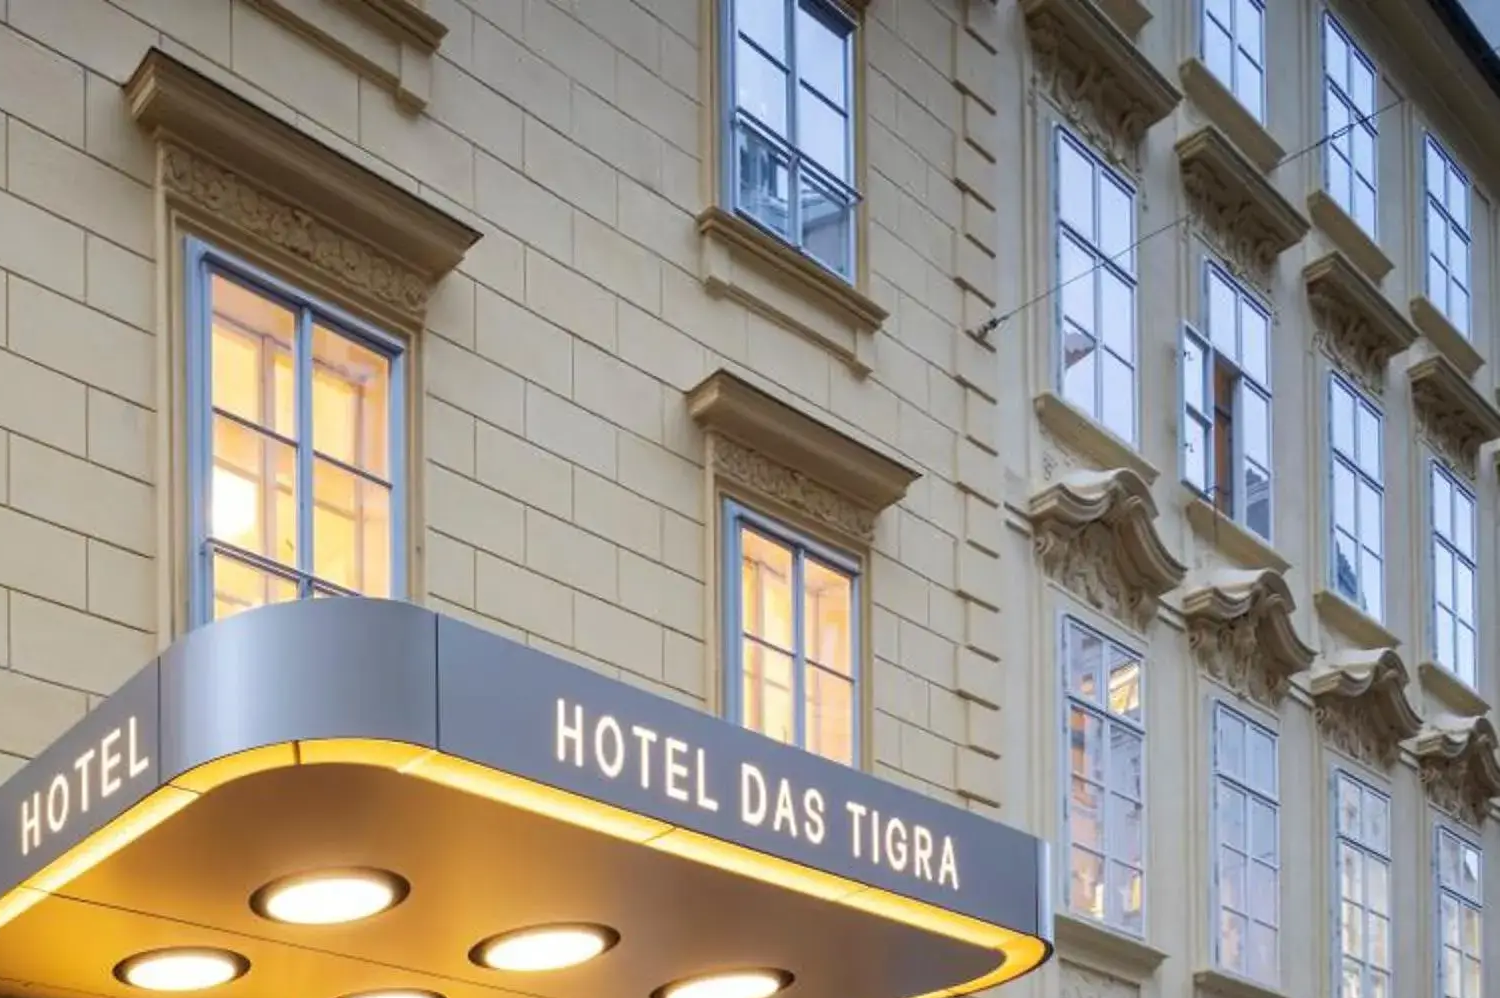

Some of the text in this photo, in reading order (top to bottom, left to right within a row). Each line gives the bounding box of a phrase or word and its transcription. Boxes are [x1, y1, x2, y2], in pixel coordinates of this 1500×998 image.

[21, 715, 149, 856] HOTEL
[556, 698, 960, 890] HOTEL DAS TIGRA
